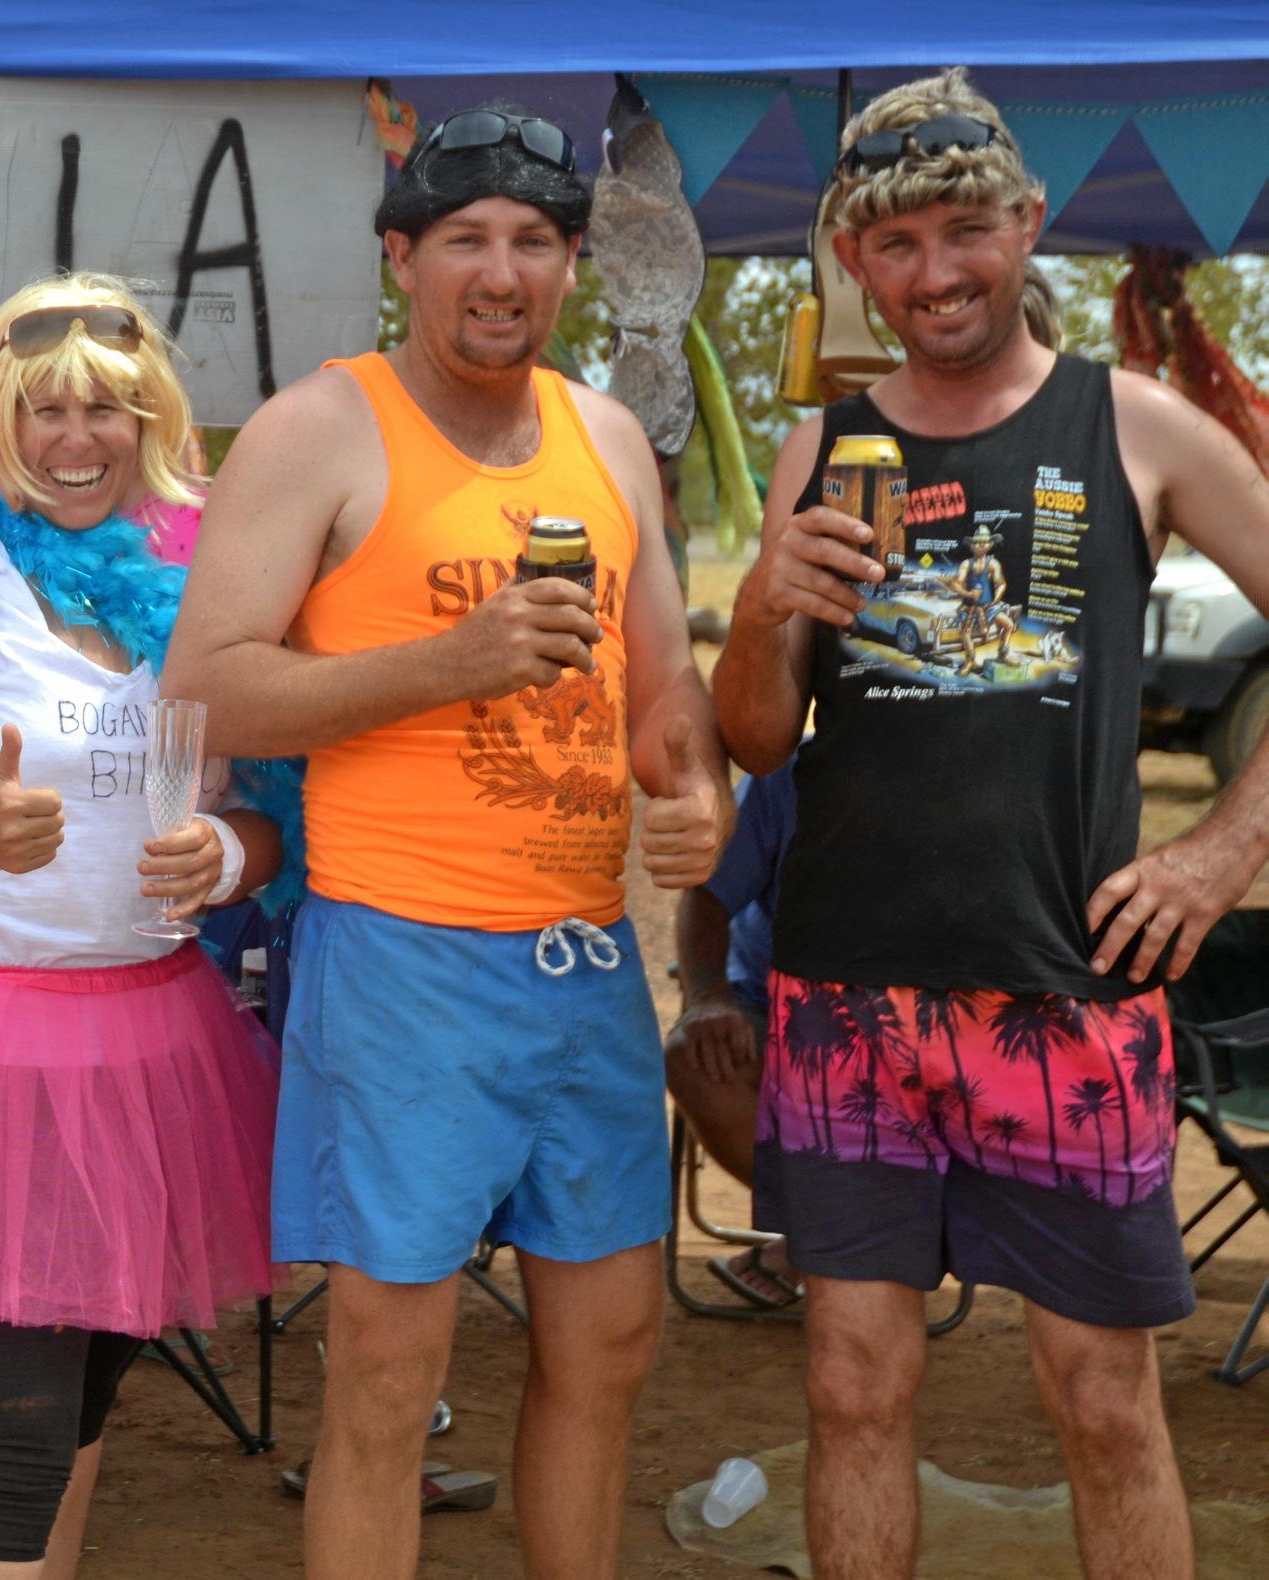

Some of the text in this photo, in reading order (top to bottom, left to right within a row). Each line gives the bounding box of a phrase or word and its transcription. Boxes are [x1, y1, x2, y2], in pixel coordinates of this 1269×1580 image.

[1037, 465, 1061, 479] THE
[1034, 478, 1084, 494] AUSSIE
[1034, 490, 1087, 514] YOBBO
[426, 557, 619, 618] SIA
[864, 685, 890, 699] Alice
[891, 685, 935, 701] Springs
[557, 746, 589, 763] Since
[542, 823, 559, 835] The
[523, 836, 559, 848] brewed
[527, 850, 546, 860] and
